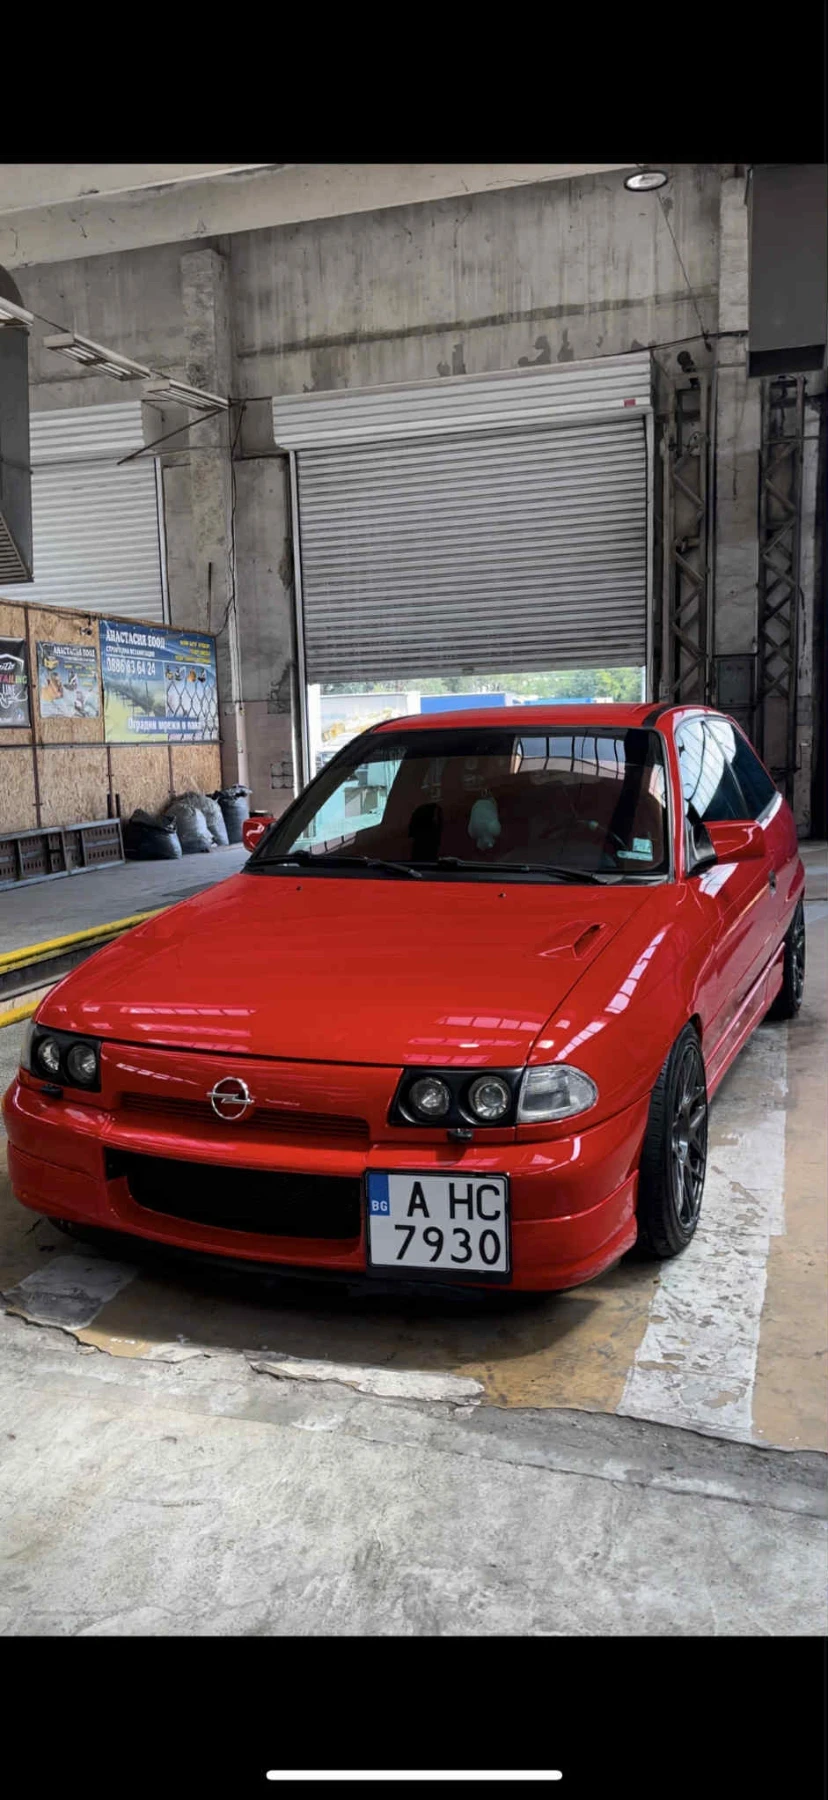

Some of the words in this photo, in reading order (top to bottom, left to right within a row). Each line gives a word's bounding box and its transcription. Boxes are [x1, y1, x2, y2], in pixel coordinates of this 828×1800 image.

[371, 1200, 388, 1211] BG
[407, 1181, 430, 1218] A
[449, 1182, 501, 1221] HC
[394, 1224, 501, 1265] 7930
